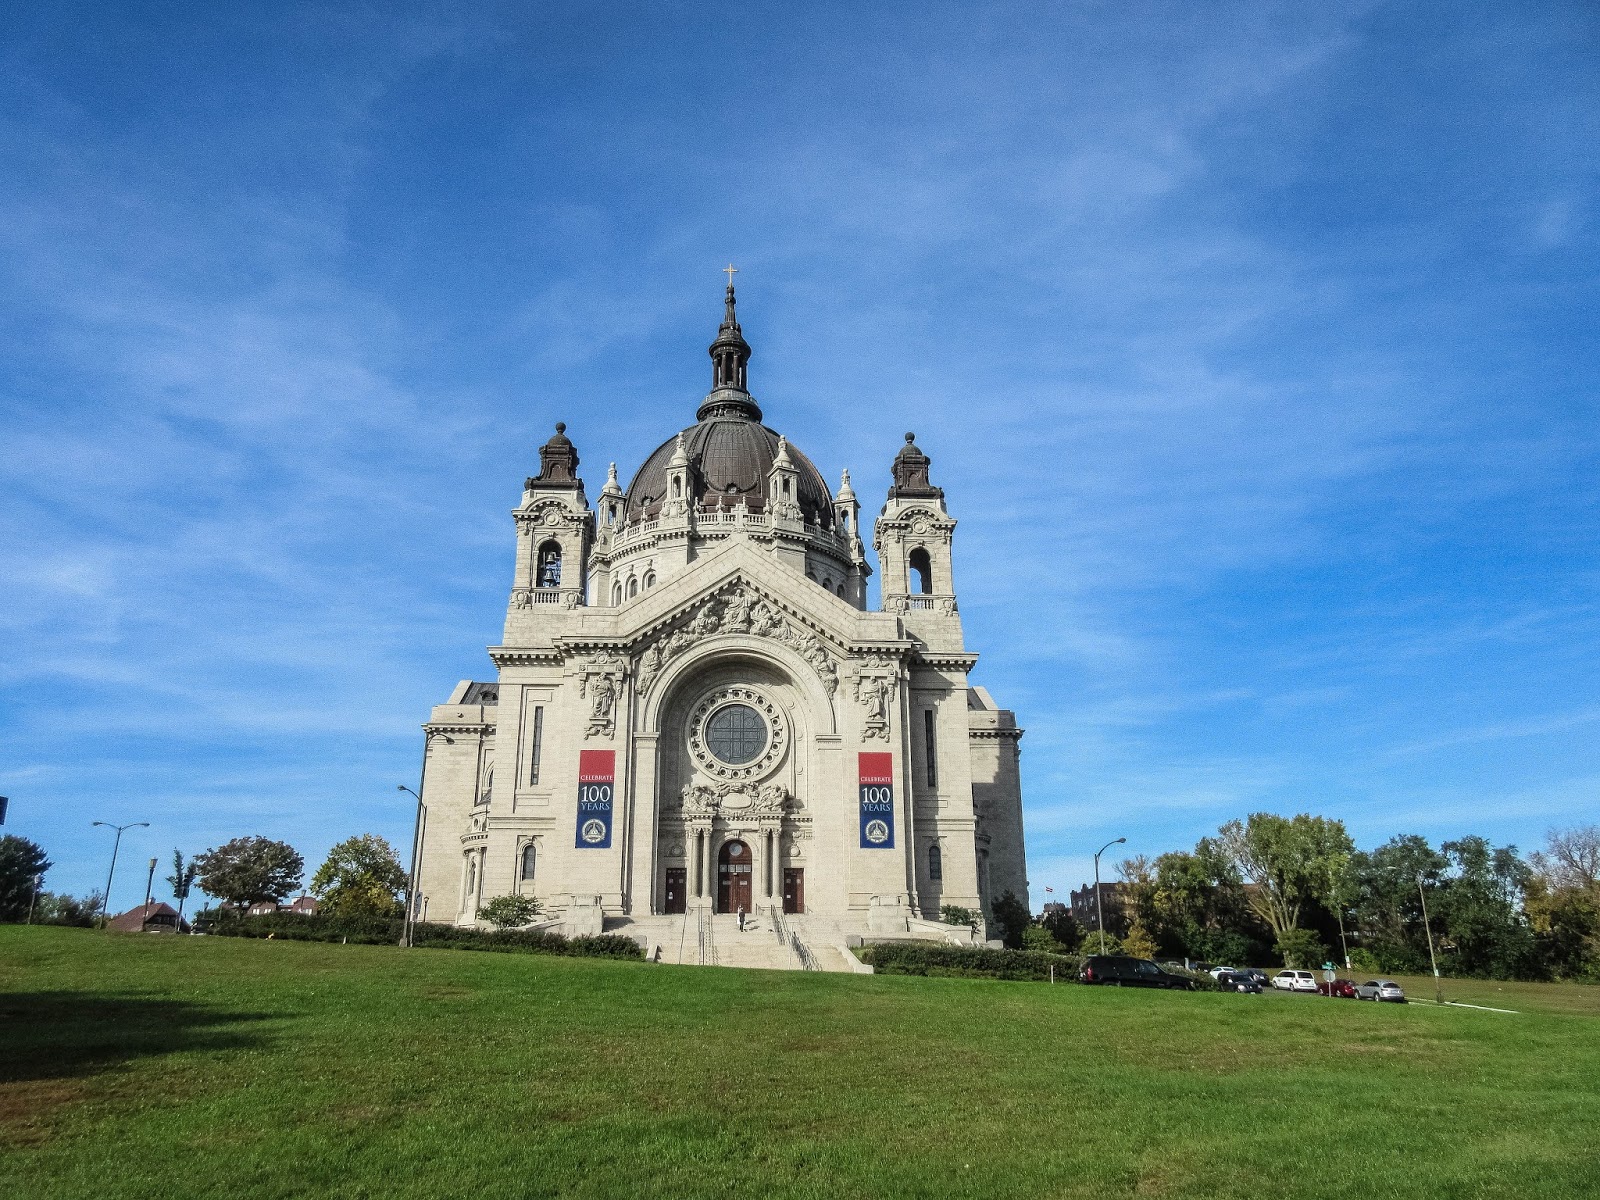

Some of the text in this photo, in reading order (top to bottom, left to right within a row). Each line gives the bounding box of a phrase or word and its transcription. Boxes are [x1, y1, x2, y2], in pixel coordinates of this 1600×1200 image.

[581, 786, 610, 802] 100
[862, 787, 890, 803] 100
[581, 802, 610, 810] YEARS
[862, 804, 891, 812] YEARS
